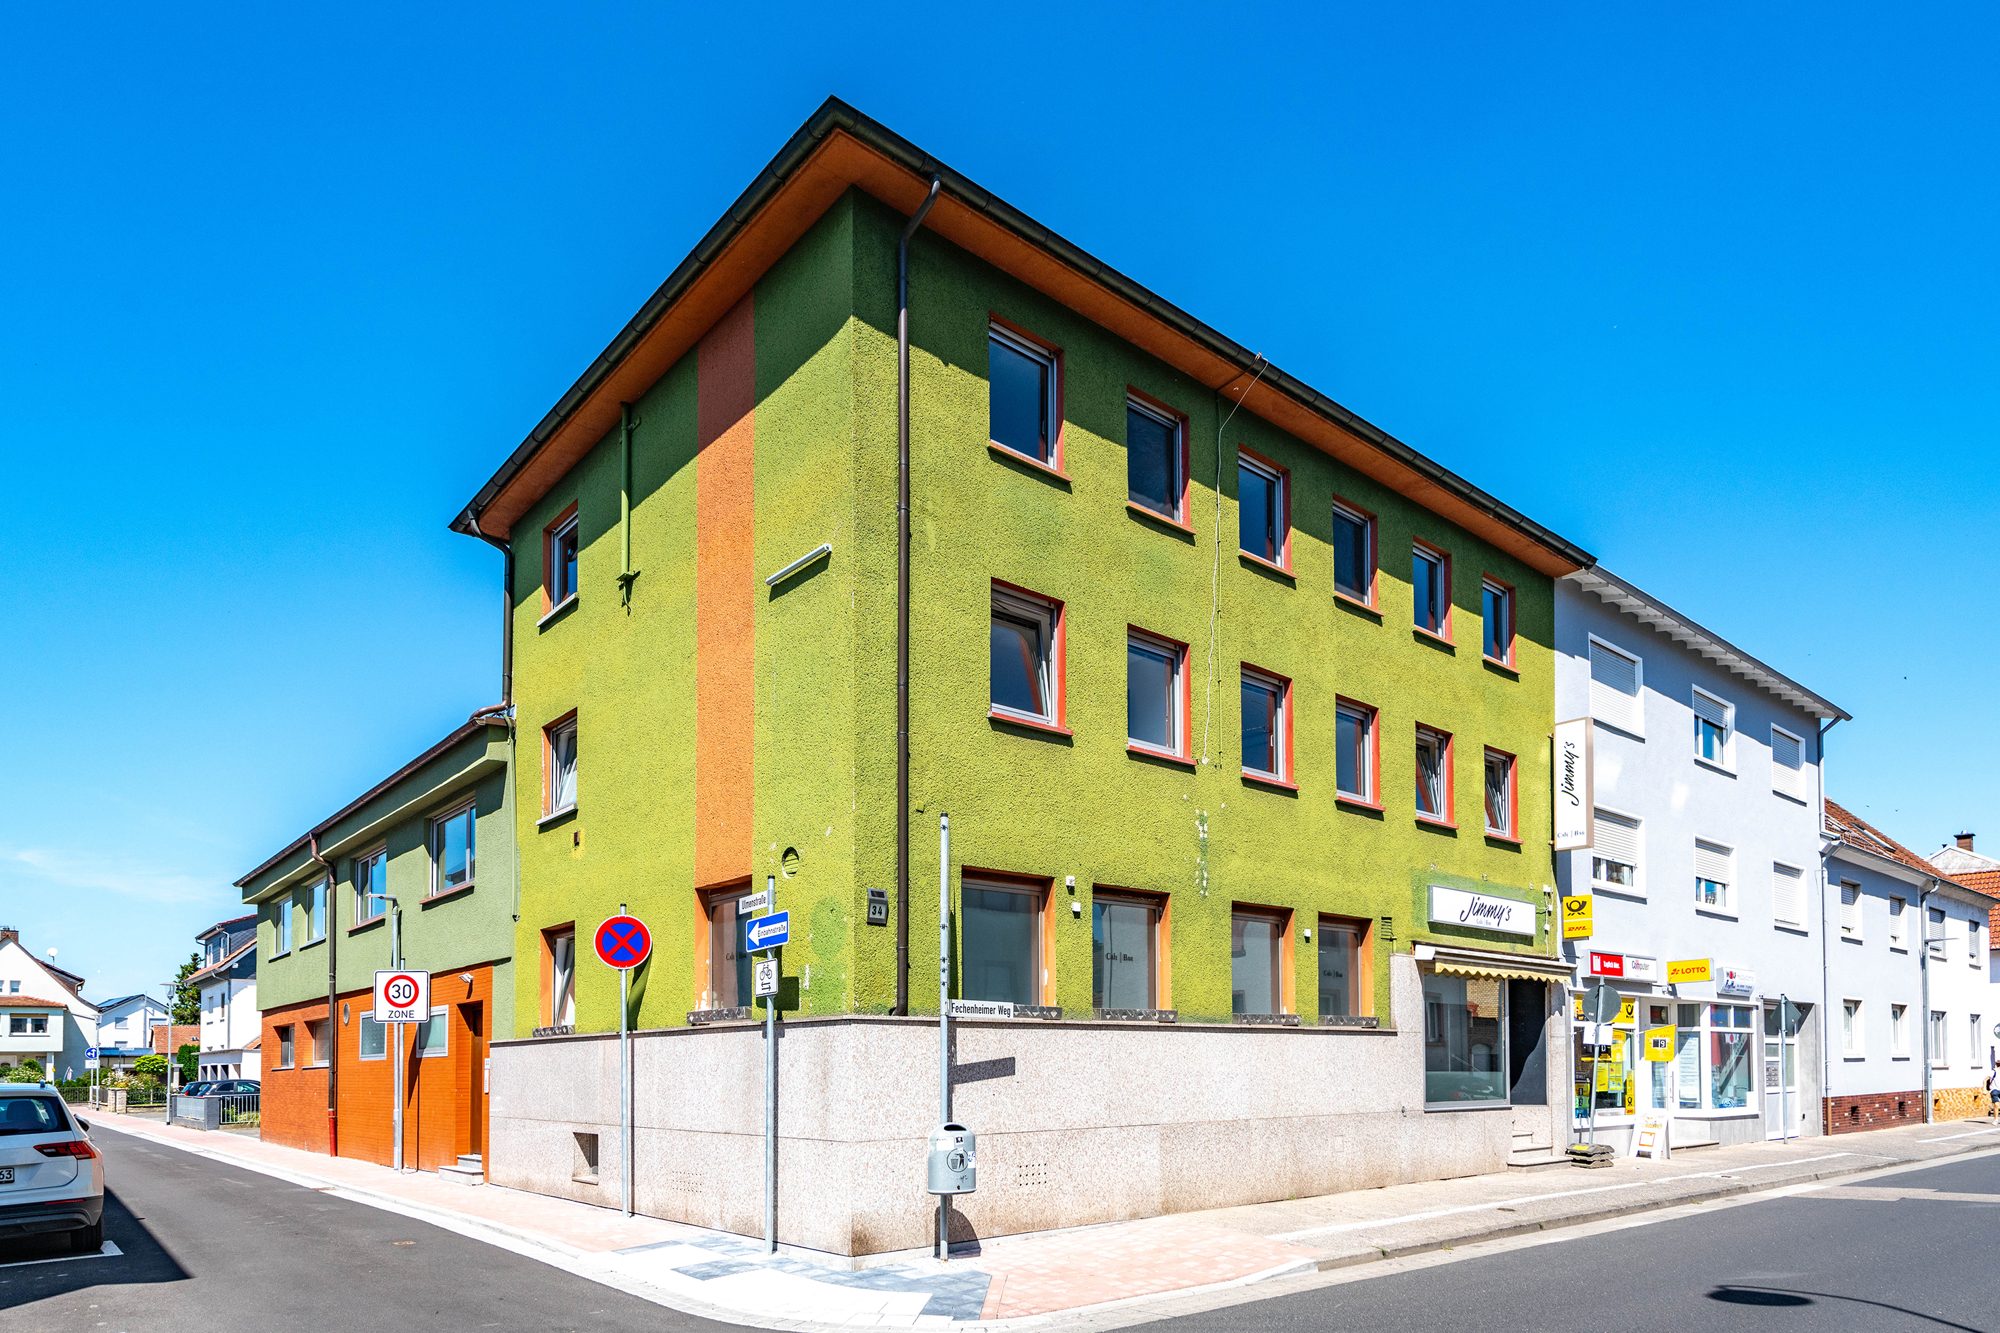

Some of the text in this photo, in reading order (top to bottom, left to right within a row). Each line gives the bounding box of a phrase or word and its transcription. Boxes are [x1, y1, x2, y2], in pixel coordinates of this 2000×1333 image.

[1561, 741, 1580, 807] Jimmy's
[742, 894, 766, 910] Ulmenstraße
[871, 905, 883, 916] 34
[1459, 896, 1513, 927] Jimmy's
[757, 924, 786, 938] Einbahnstraße
[1681, 966, 1707, 975] LOTTO
[391, 984, 412, 999] 30
[388, 1009, 415, 1019] ZONE
[951, 1002, 1011, 1017] Fechenheimer Weg
